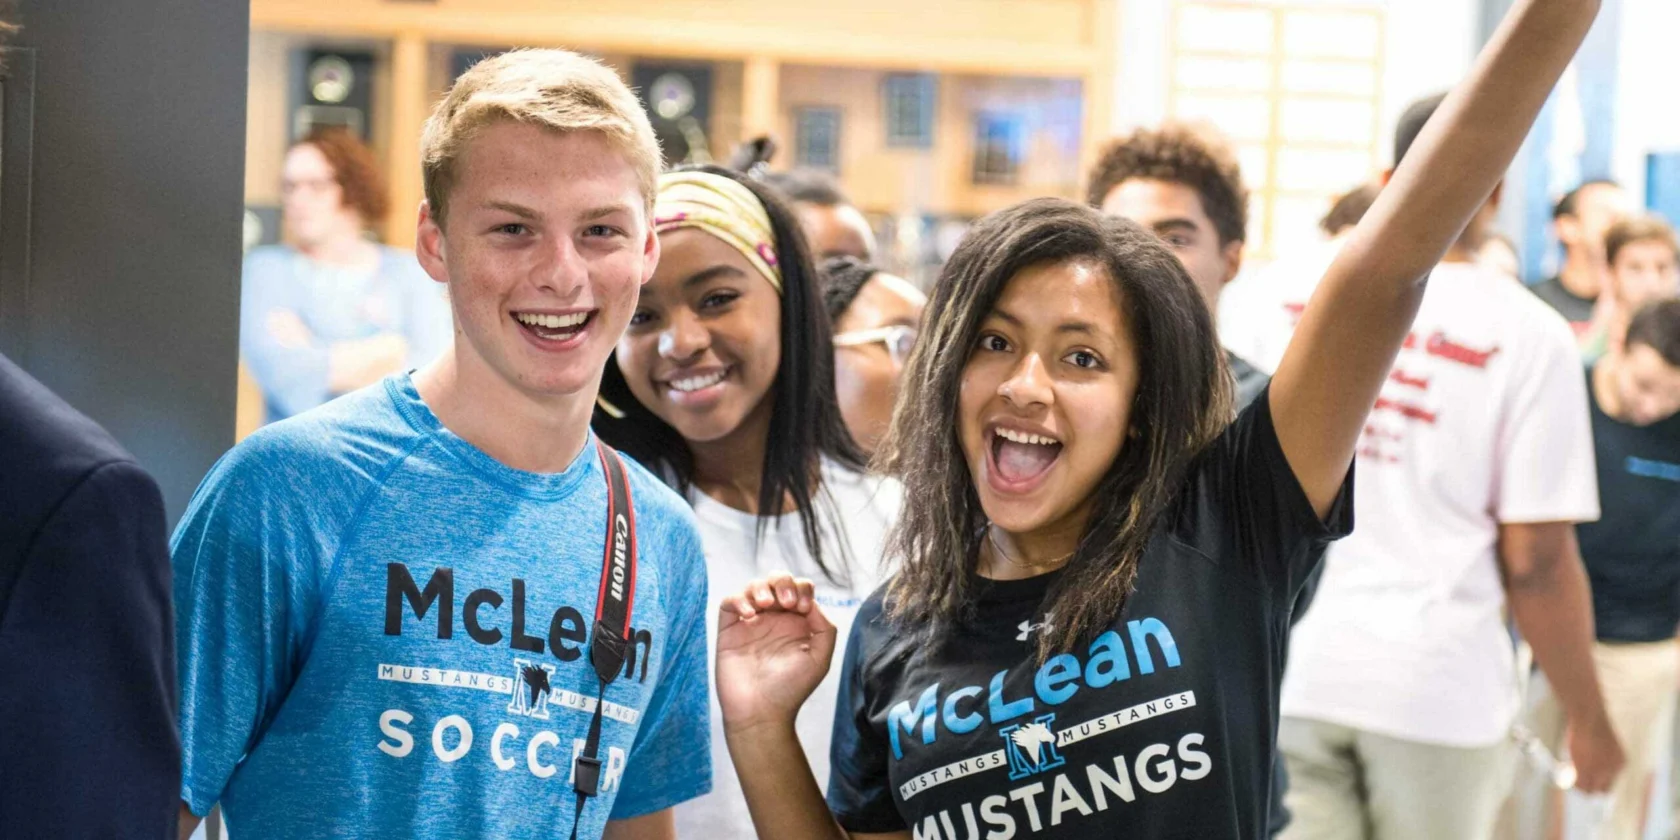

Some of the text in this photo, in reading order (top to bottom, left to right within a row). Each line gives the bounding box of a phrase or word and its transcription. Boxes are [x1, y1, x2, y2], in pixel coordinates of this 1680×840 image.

[611, 513, 628, 602] Canon
[384, 562, 653, 684] McLen
[382, 665, 509, 690] MUSTANGS
[887, 616, 1182, 760] McLean
[901, 753, 1000, 798] MUSTANGS
[1062, 694, 1189, 744] MUSTANGS
